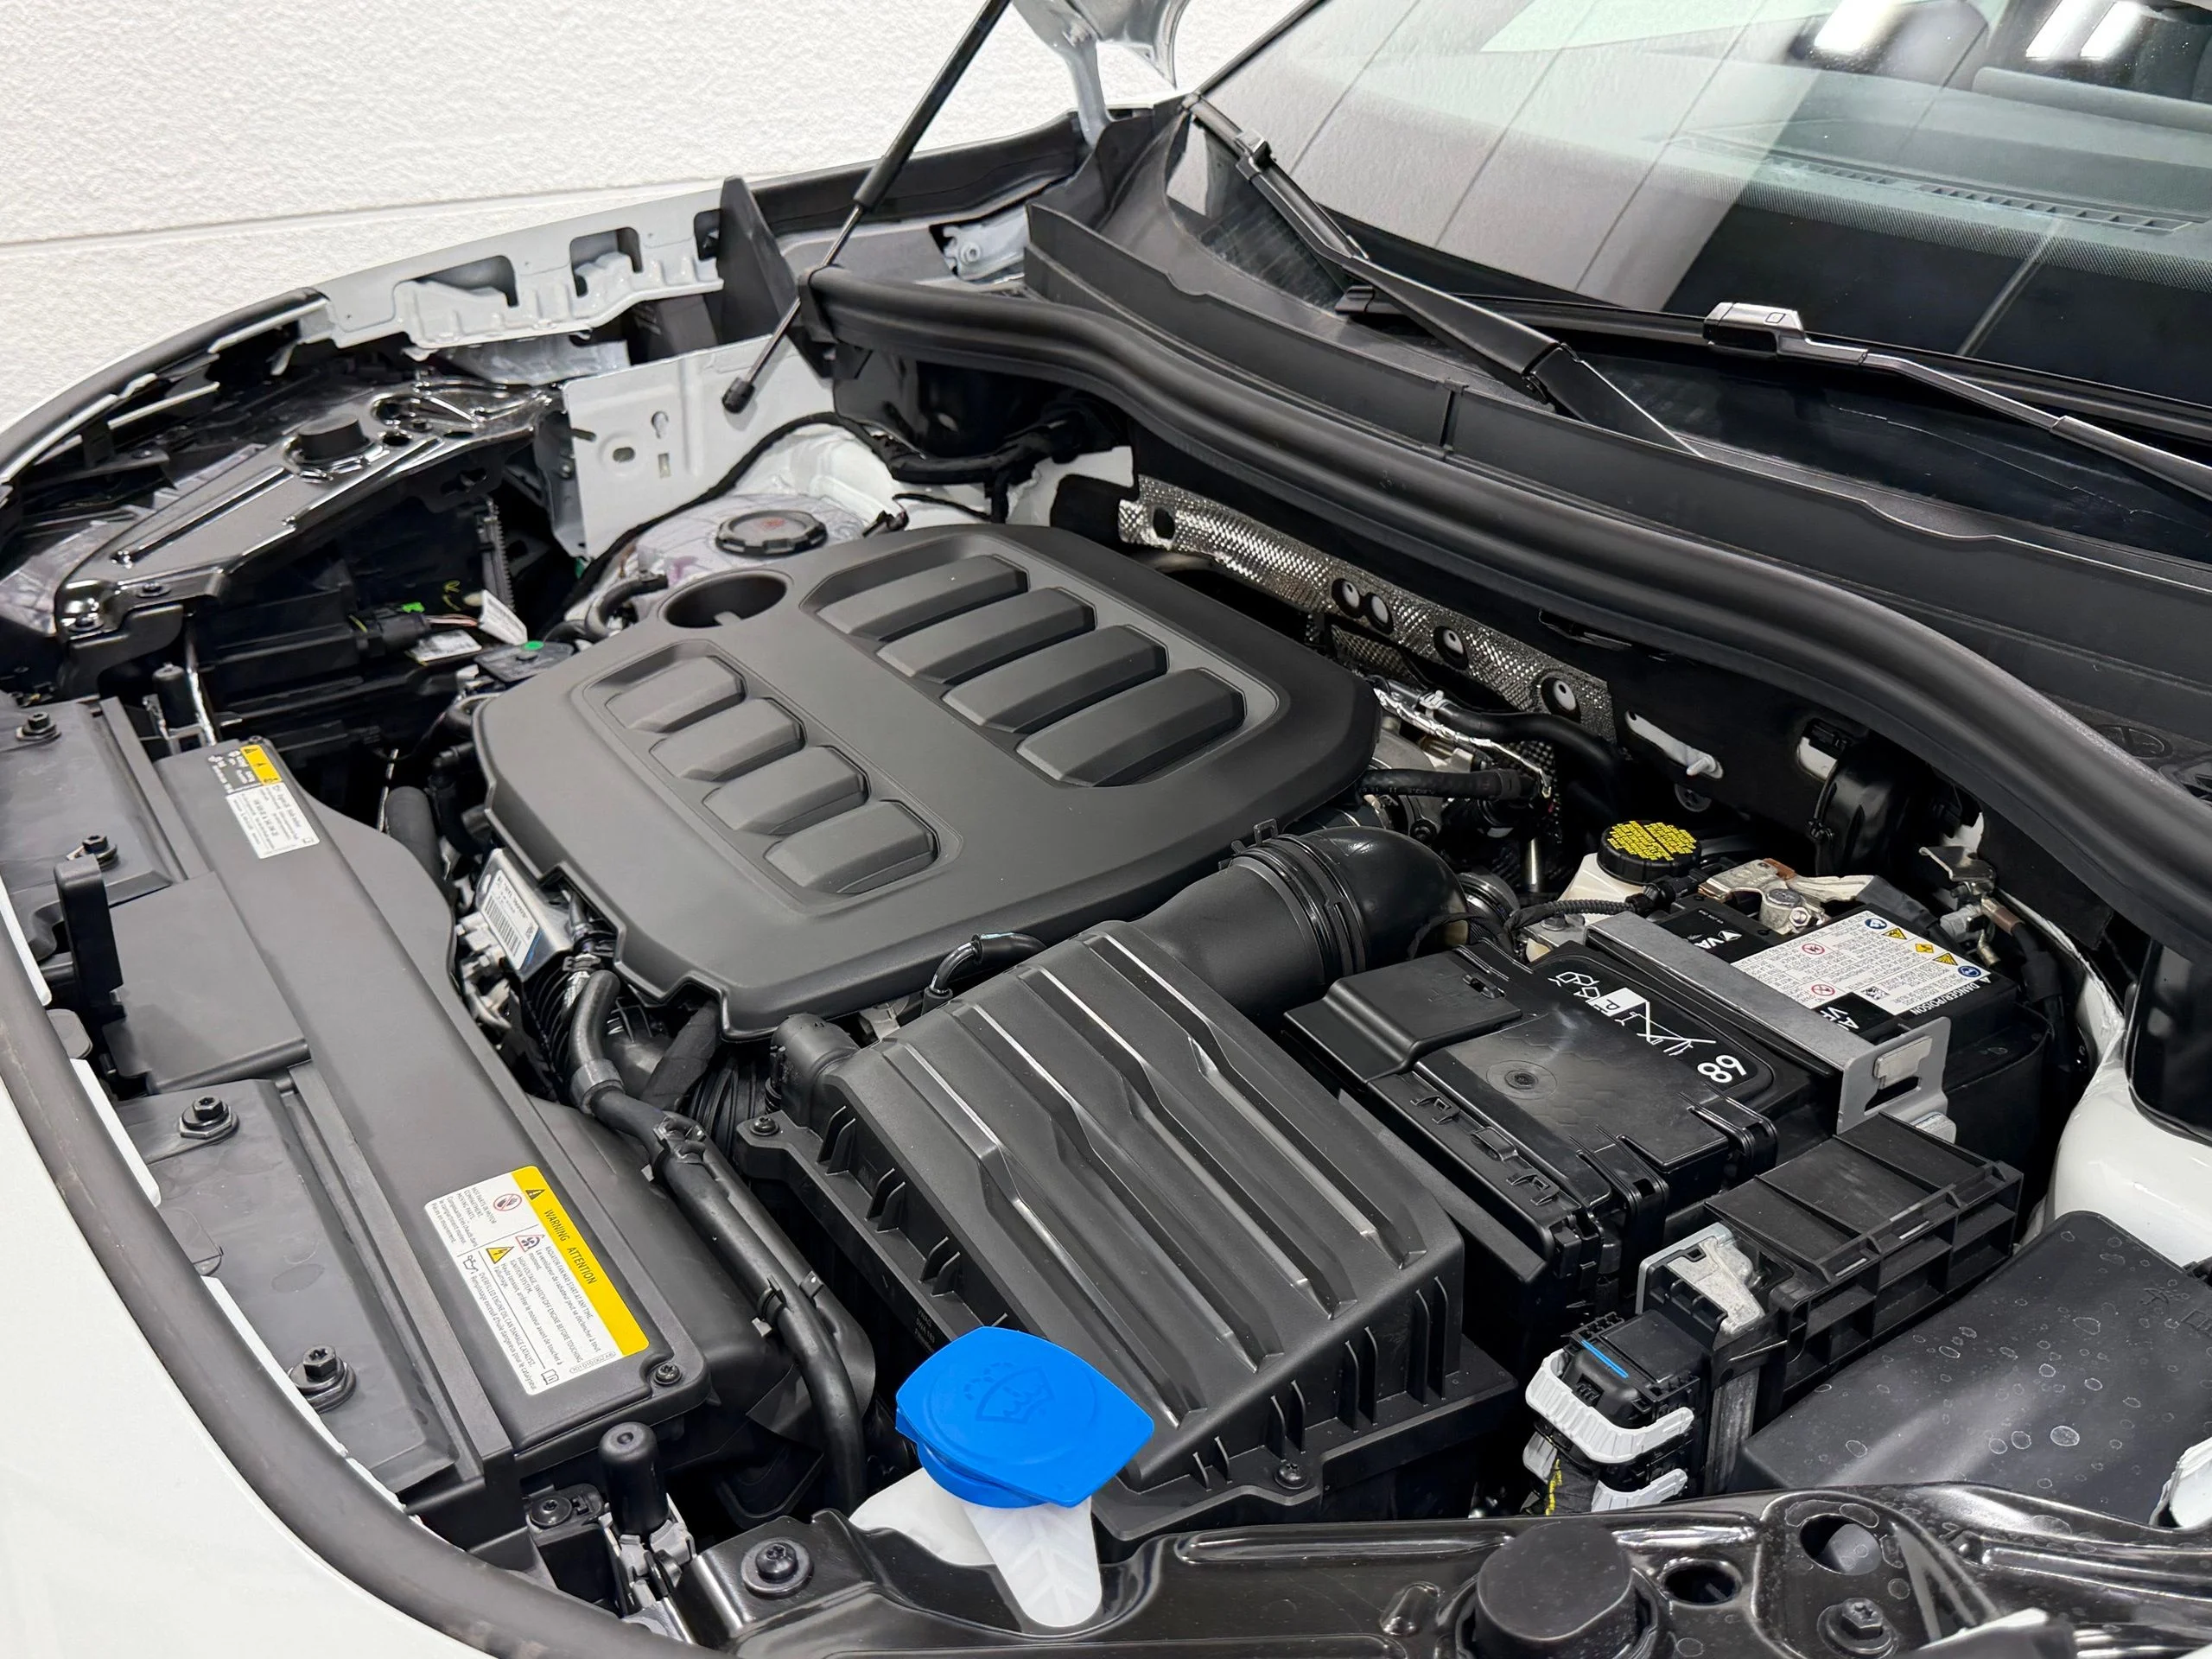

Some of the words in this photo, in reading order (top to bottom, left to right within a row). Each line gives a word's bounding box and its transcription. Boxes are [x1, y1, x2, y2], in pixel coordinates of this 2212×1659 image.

[1910, 982, 1980, 1015] DANGER/POISON
[542, 1208, 571, 1242] WARNING
[565, 1244, 598, 1285] ATTENTION
[516, 1255, 528, 1268] HIGH
[477, 1271, 497, 1297] OVERFILLED
[532, 1283, 548, 1300] SWITCH
[490, 1294, 505, 1312] ENGINE
[541, 1299, 552, 1309] OFF
[499, 1310, 509, 1319] OIL
[503, 1318, 515, 1329] CAN
[546, 1306, 562, 1325] ENGINE
[508, 1326, 524, 1346] DAMAGE
[555, 1322, 571, 1341] BEFORE
[565, 1338, 584, 1363] TOUCHING
